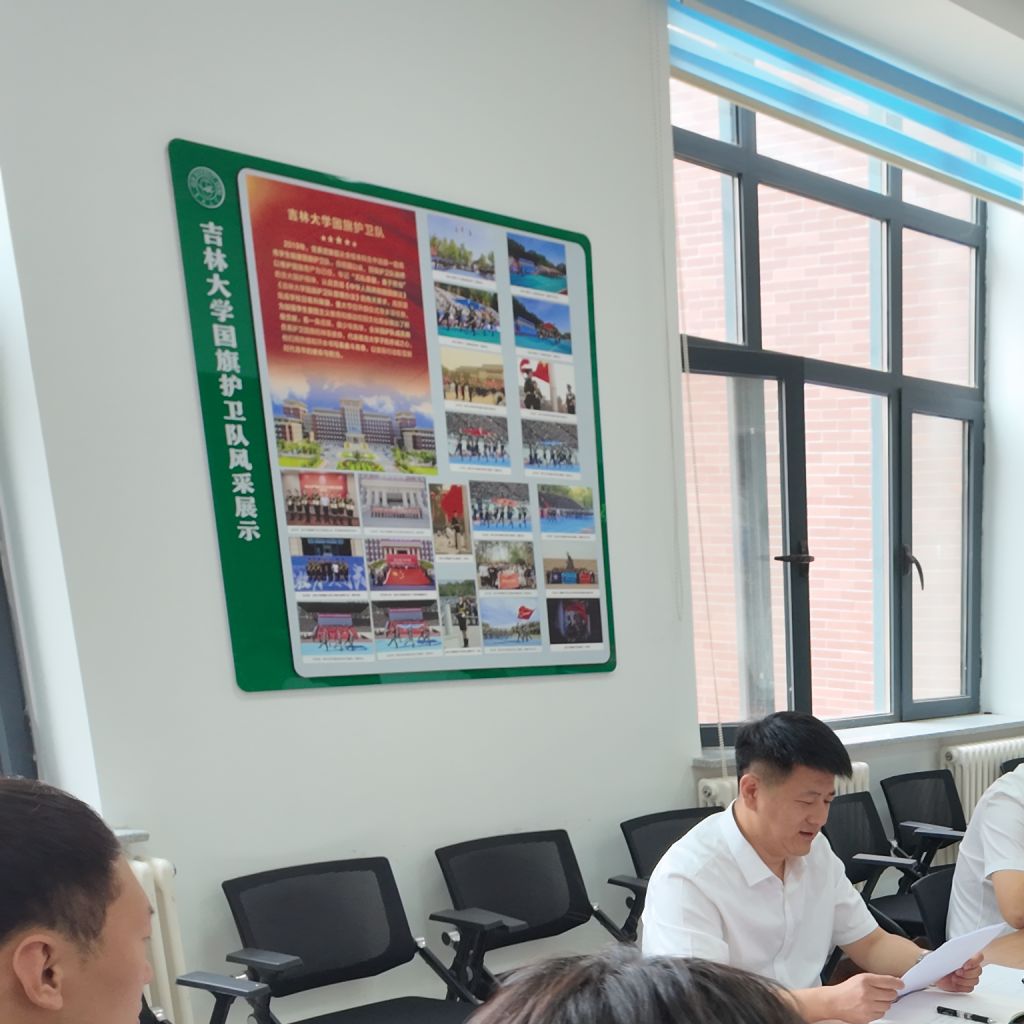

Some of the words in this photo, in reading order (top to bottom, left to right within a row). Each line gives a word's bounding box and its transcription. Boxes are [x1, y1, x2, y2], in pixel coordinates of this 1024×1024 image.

[200, 221, 261, 541] 吉林大学国旗护卫队风采展示
